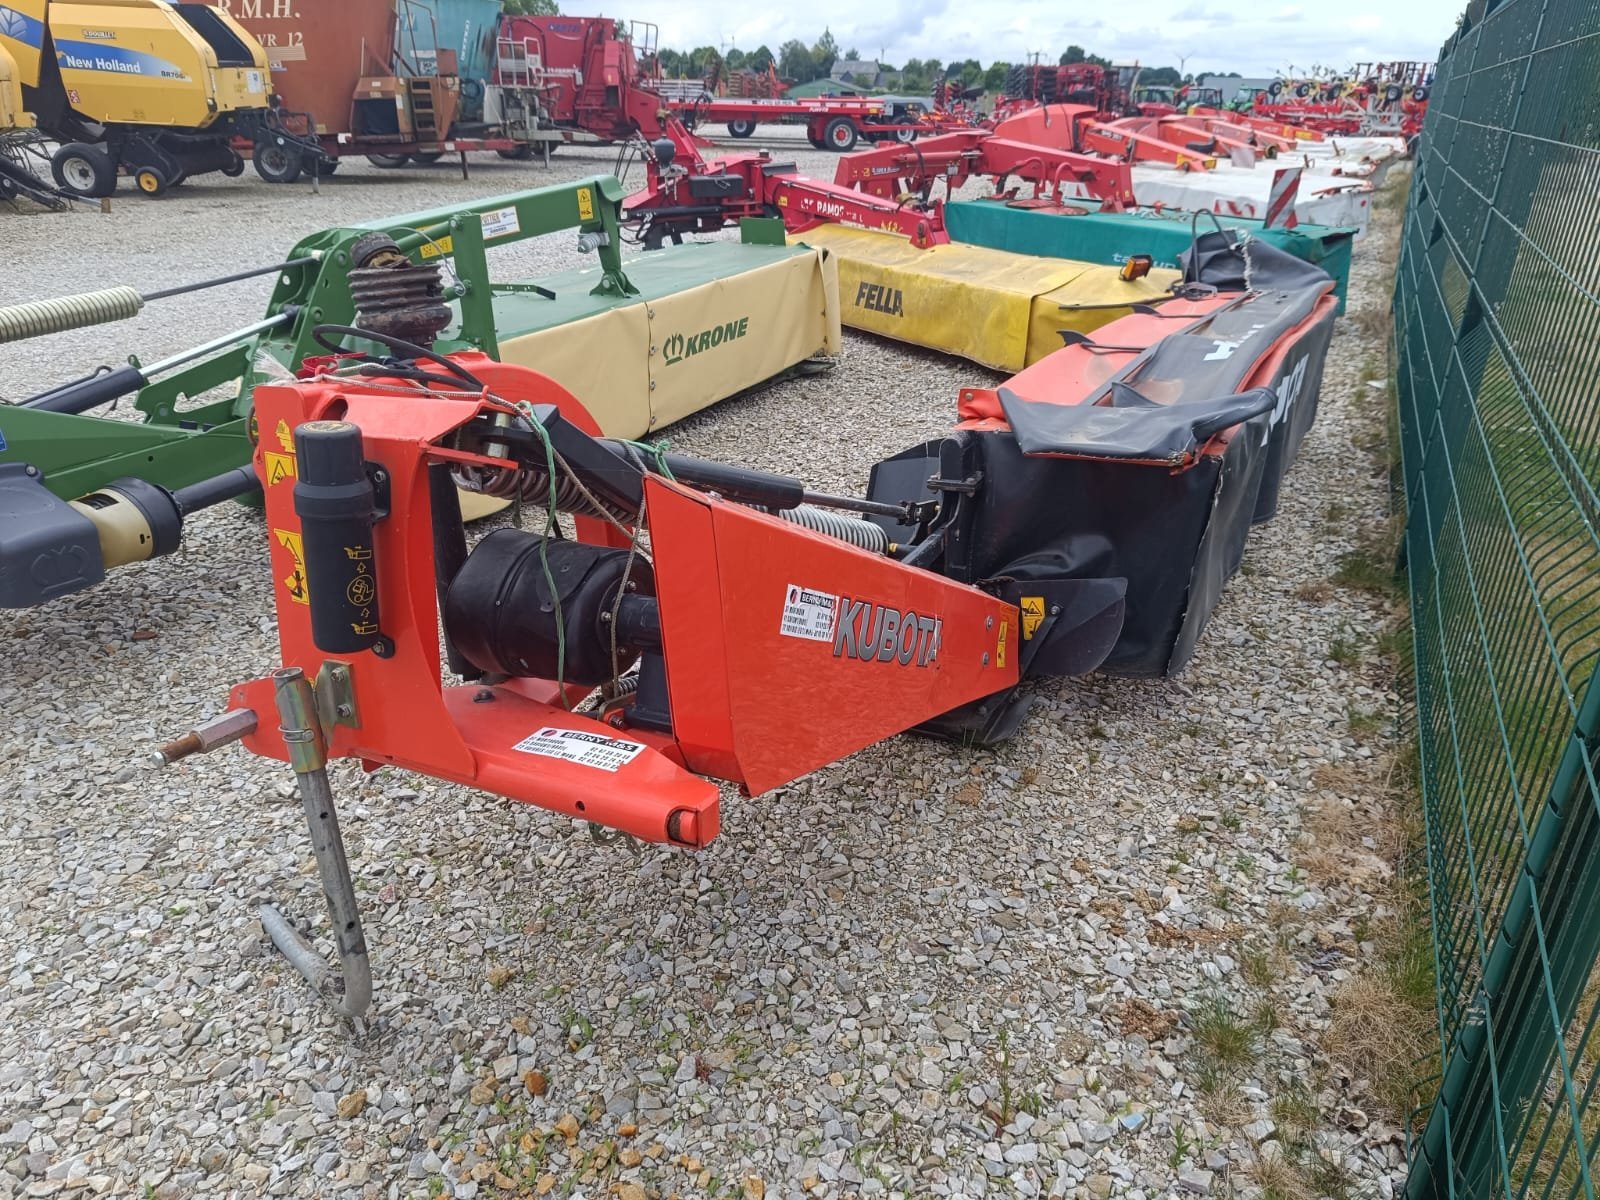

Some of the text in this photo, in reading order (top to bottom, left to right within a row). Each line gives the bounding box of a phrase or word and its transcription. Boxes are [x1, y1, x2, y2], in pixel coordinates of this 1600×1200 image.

[288, 32, 303, 47] 12
[66, 55, 141, 73] New Holland
[855, 281, 903, 317] FELLA
[684, 316, 749, 359] KRONE
[564, 732, 601, 745] BERNY
